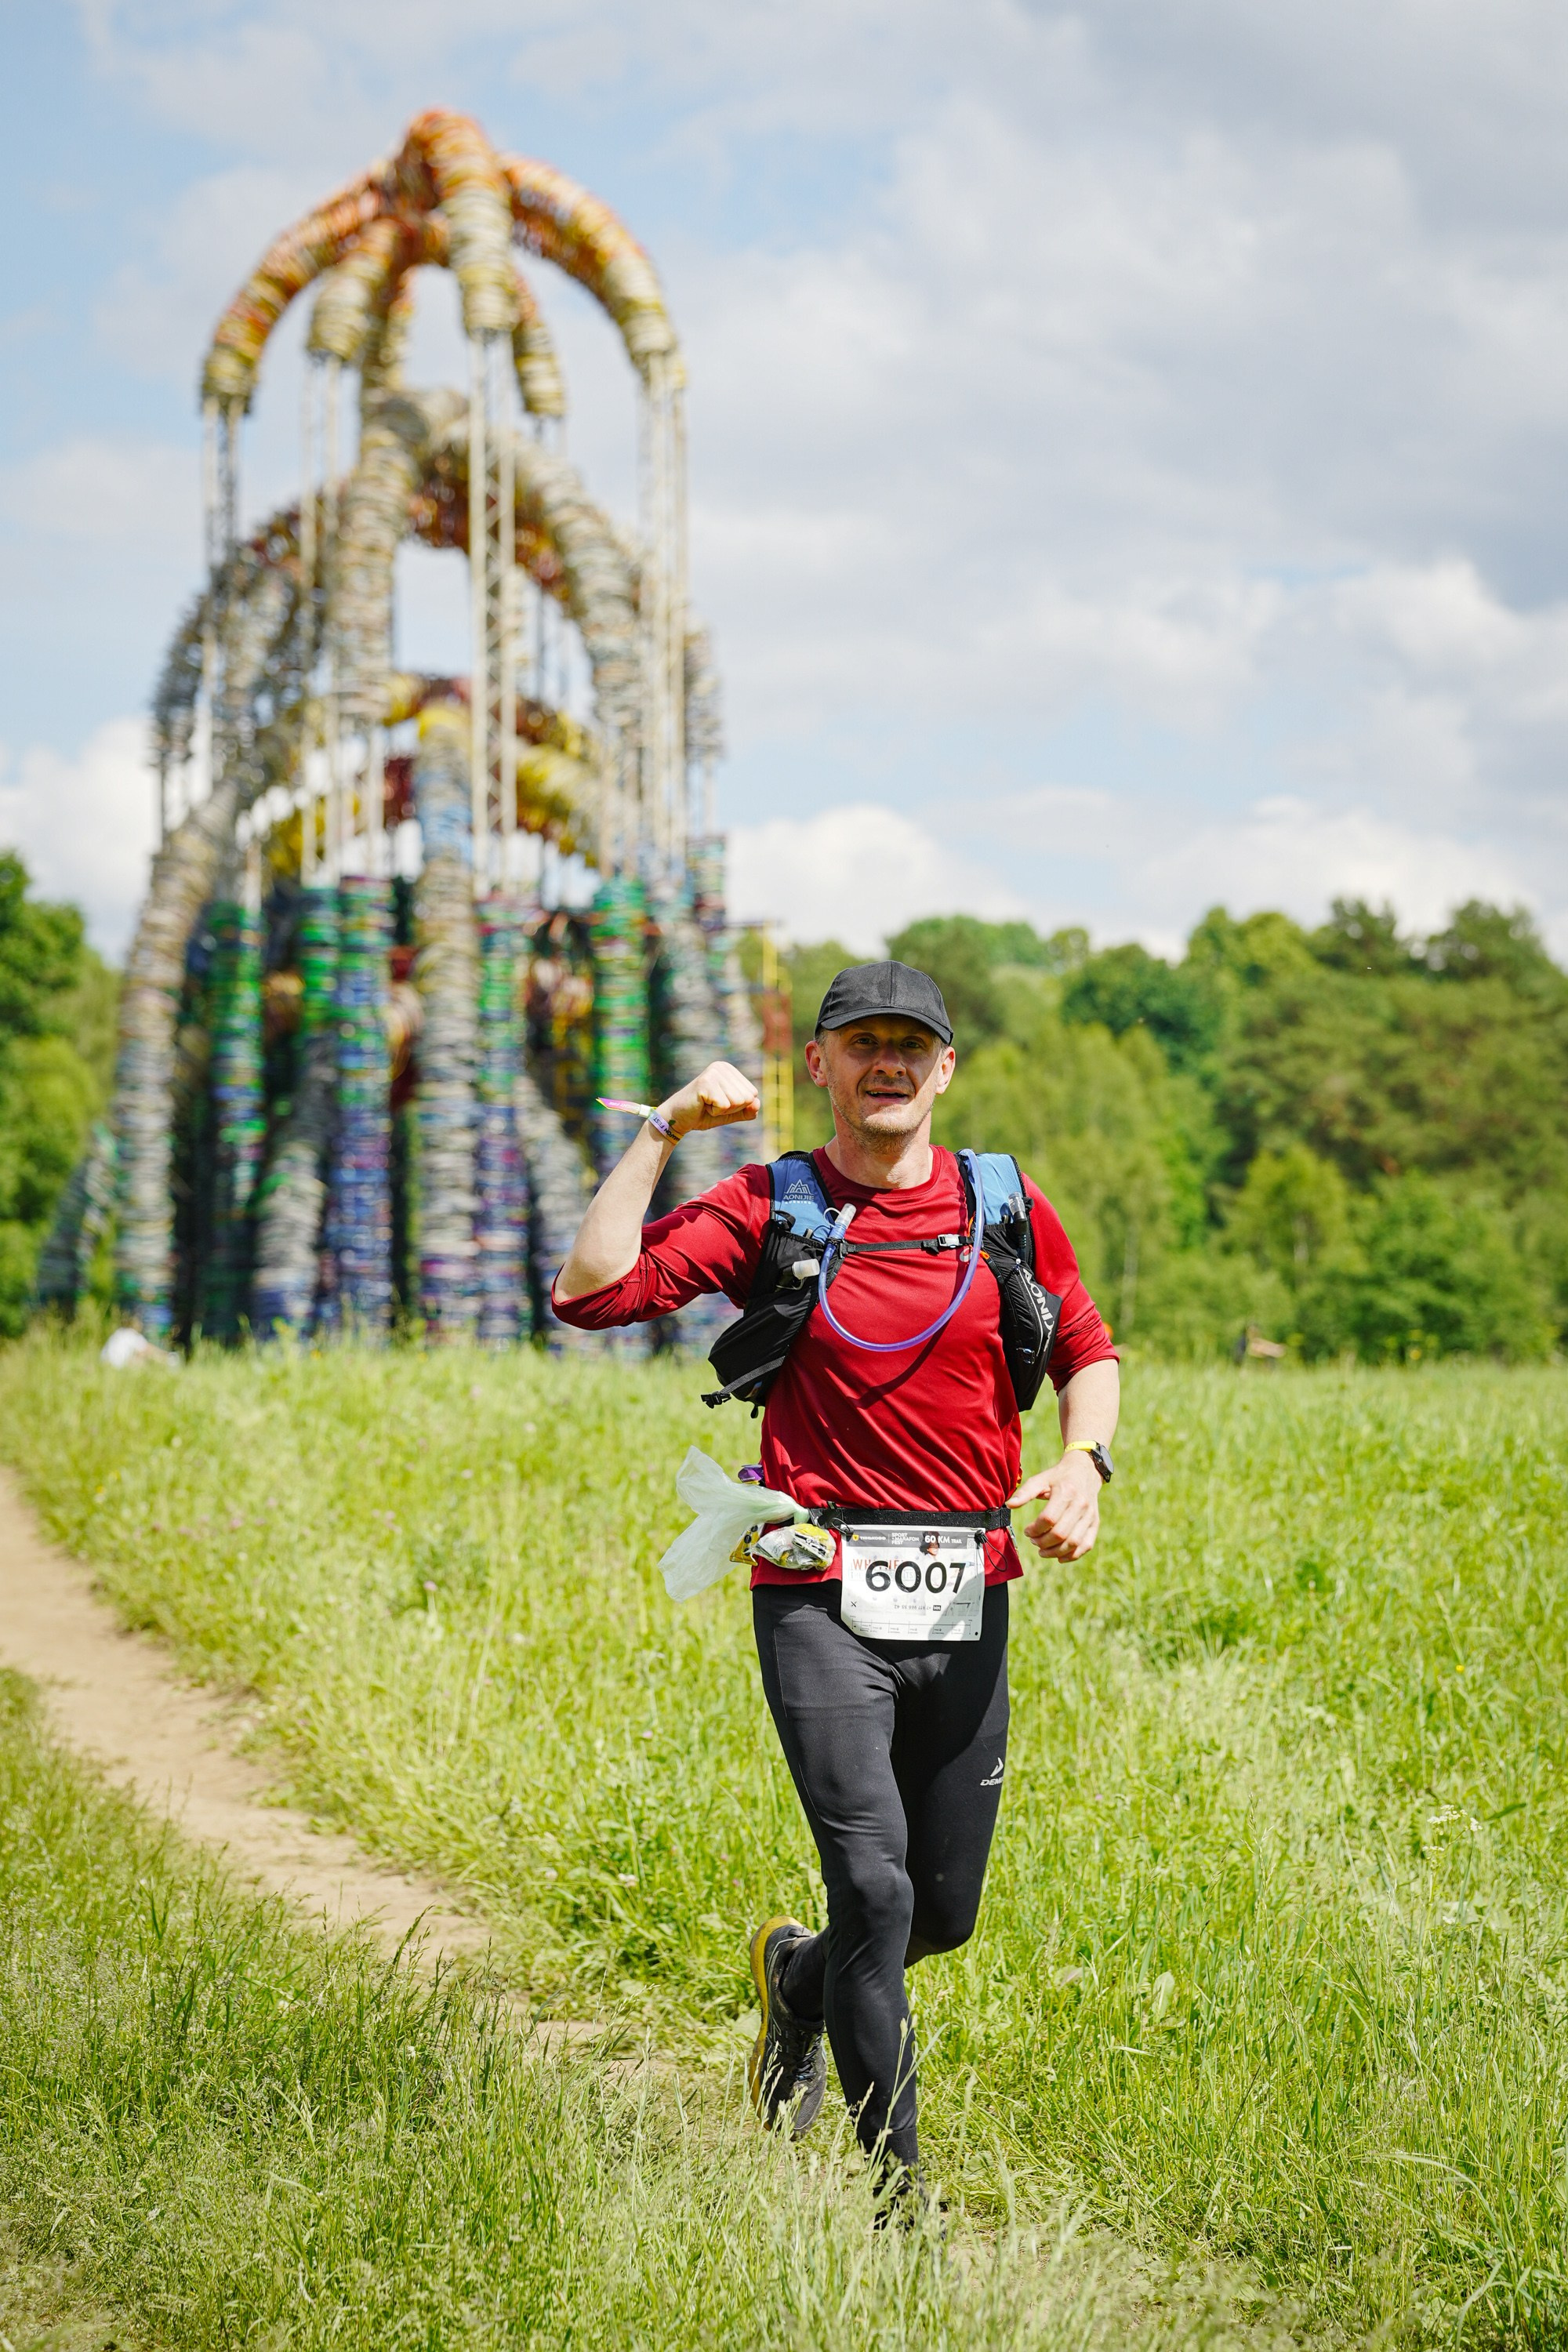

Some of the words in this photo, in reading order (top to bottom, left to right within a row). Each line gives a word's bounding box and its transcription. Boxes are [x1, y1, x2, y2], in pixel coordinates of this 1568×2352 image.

[653, 1117, 665, 1129] FEST
[924, 1535, 936, 1544] 60
[938, 1535, 950, 1544] KM
[866, 1560, 966, 1594] 6007
